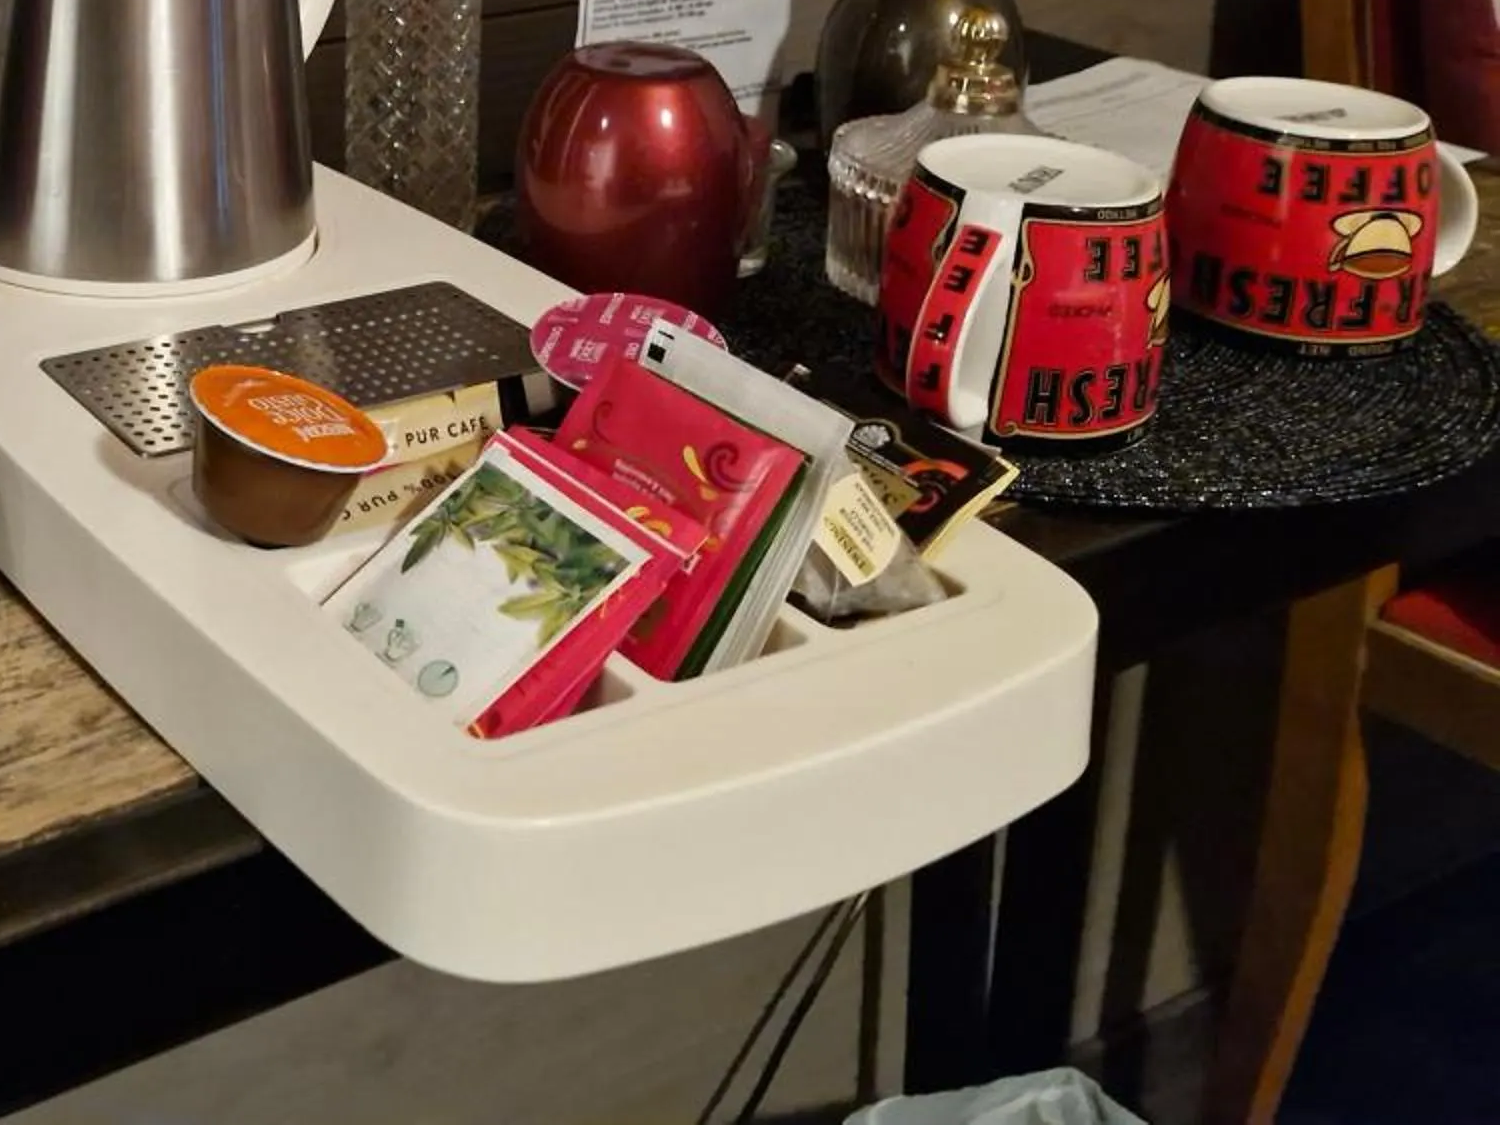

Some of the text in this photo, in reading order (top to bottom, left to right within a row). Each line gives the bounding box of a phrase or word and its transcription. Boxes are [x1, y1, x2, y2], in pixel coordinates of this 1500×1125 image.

[1258, 155, 1433, 205] OFFEE
[1084, 229, 1162, 282] FEE
[1023, 358, 1156, 425] RESH
[405, 426, 440, 448] PUR
[357, 490, 399, 513] PUR
